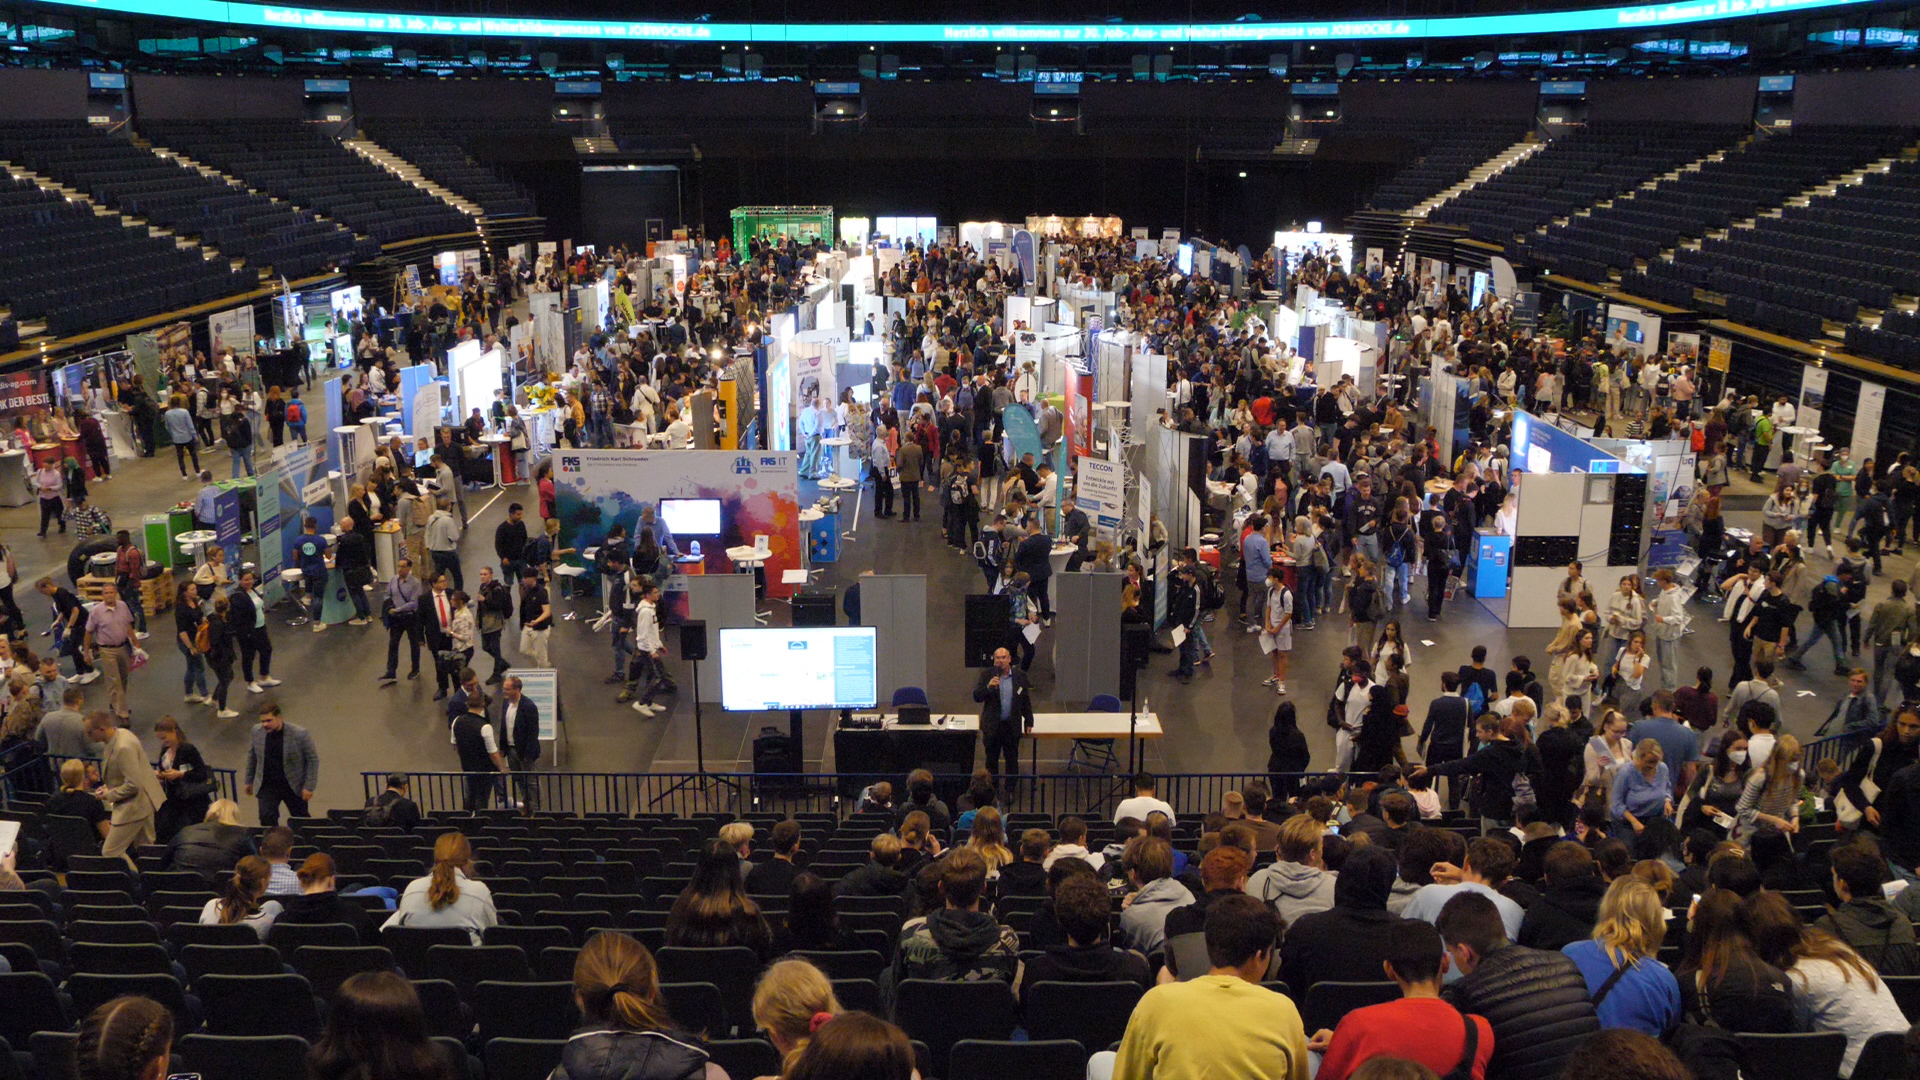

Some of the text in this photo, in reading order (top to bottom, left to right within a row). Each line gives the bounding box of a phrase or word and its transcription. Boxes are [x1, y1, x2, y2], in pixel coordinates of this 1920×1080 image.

[264, 8, 302, 23] Herzlich
[303, 12, 366, 28] willkommen
[368, 17, 385, 28] zur
[387, 16, 405, 29] 30.
[459, 19, 481, 32] und
[482, 20, 601, 37] Weiterbildungsmesse
[604, 25, 626, 35] von
[627, 24, 711, 38] JOBWOCHE.de
[944, 26, 989, 39] Herzlich
[991, 26, 1060, 39] willkommen
[1063, 29, 1081, 39] zur
[1084, 27, 1100, 39] 30.
[1131, 27, 1158, 39] Aus-
[1160, 27, 1182, 38] und
[1185, 25, 1304, 40] Weiterbildungsmesse
[1307, 26, 1328, 37] von
[1330, 22, 1410, 36] JOBWOCHE.de
[8, 397, 25, 407] DER
[562, 457, 580, 466] FKS
[760, 457, 788, 466] FKS IT
[1089, 462, 1113, 472] TECCON
[1085, 475, 1106, 483] Entwickle
[1098, 483, 1117, 491] Zukunft!
